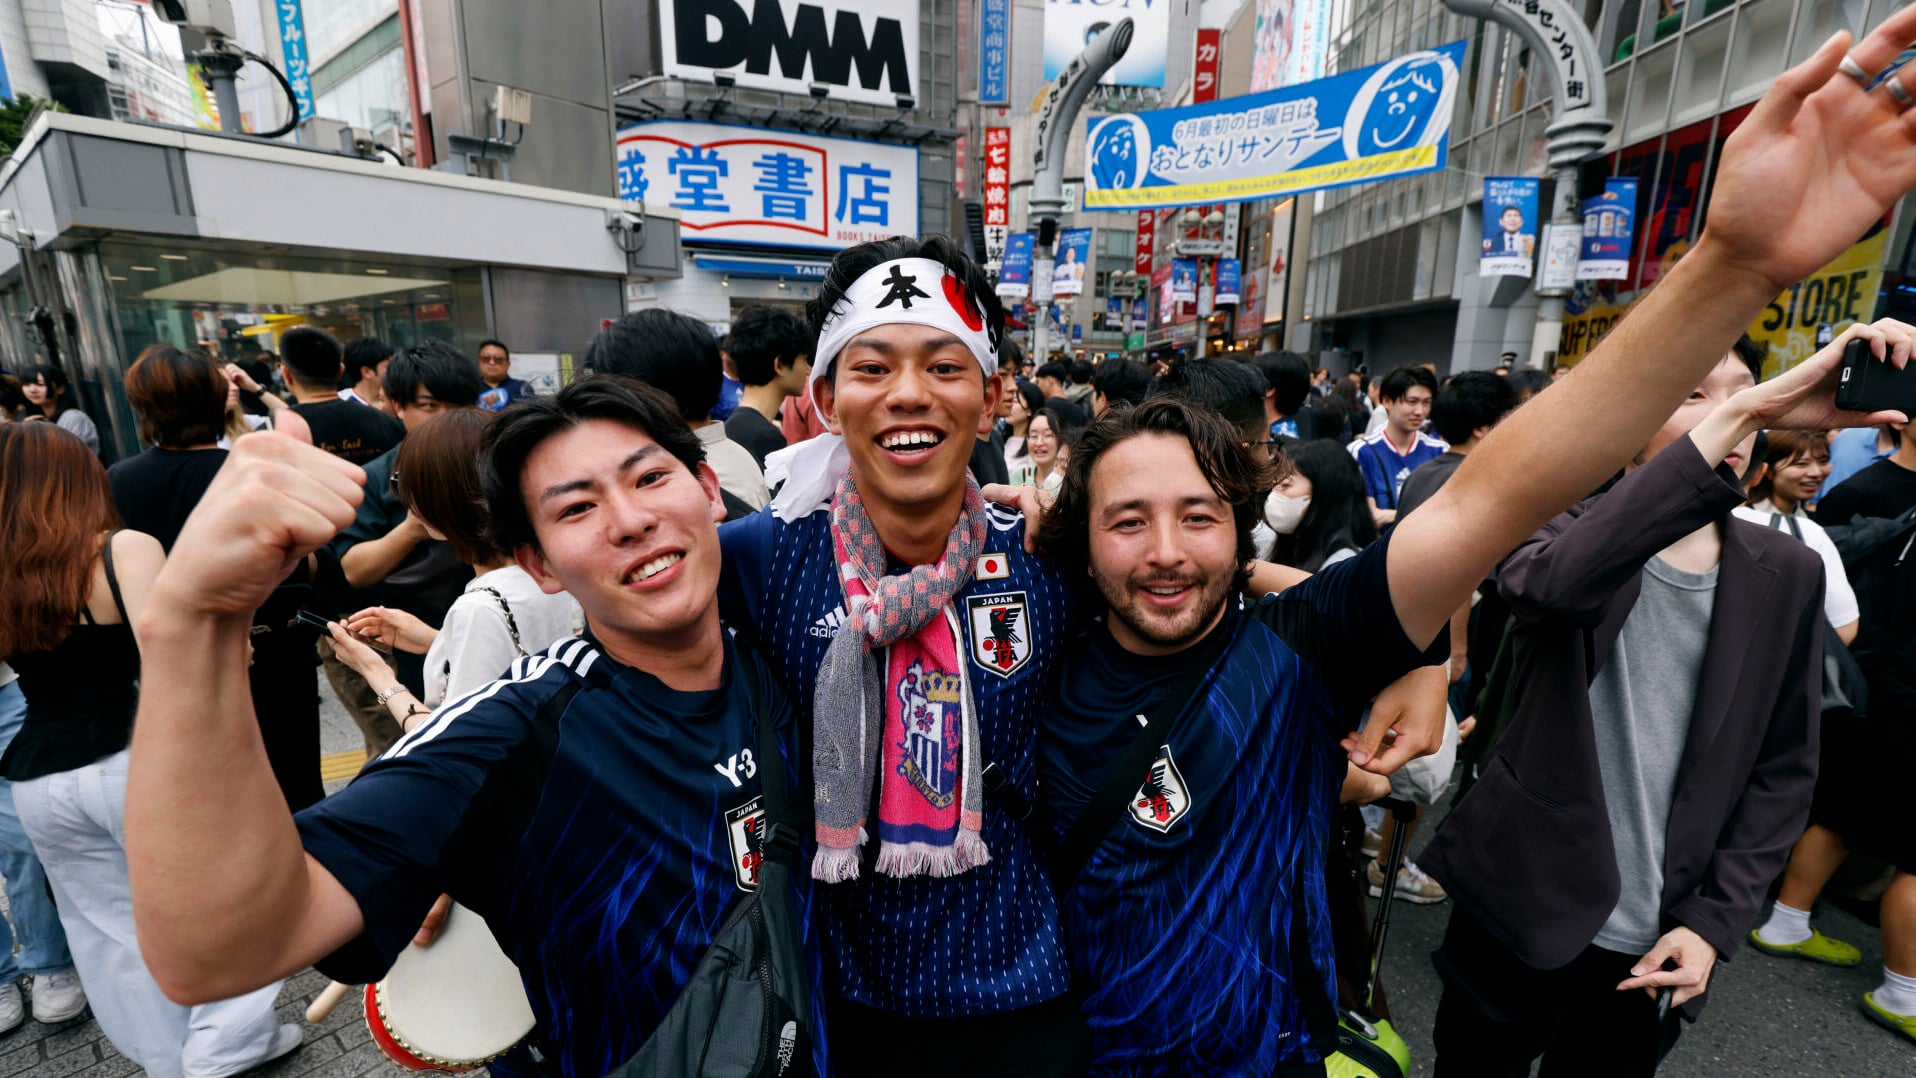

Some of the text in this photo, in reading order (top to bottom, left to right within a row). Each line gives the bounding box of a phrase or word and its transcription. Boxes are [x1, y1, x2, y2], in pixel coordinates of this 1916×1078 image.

[281, 0, 310, 116] フルーツギフ
[673, 0, 911, 96] DMM
[1508, 0, 1583, 99] 谷センター街
[1174, 101, 1313, 140] 6月最初の日曜日は
[1153, 122, 1339, 172] おとなりサンデー
[837, 230, 864, 241] BOOKS
[875, 264, 932, 309] 本
[1762, 271, 1867, 331] STORE
[981, 595, 1014, 606] JAPAN
[991, 652, 1019, 665] JFA
[713, 748, 757, 788] Y-3
[736, 801, 758, 818] JAPAN
[1149, 802, 1176, 819] JFA
[777, 1039, 785, 1060] THE
[783, 1041, 795, 1067] FACE
